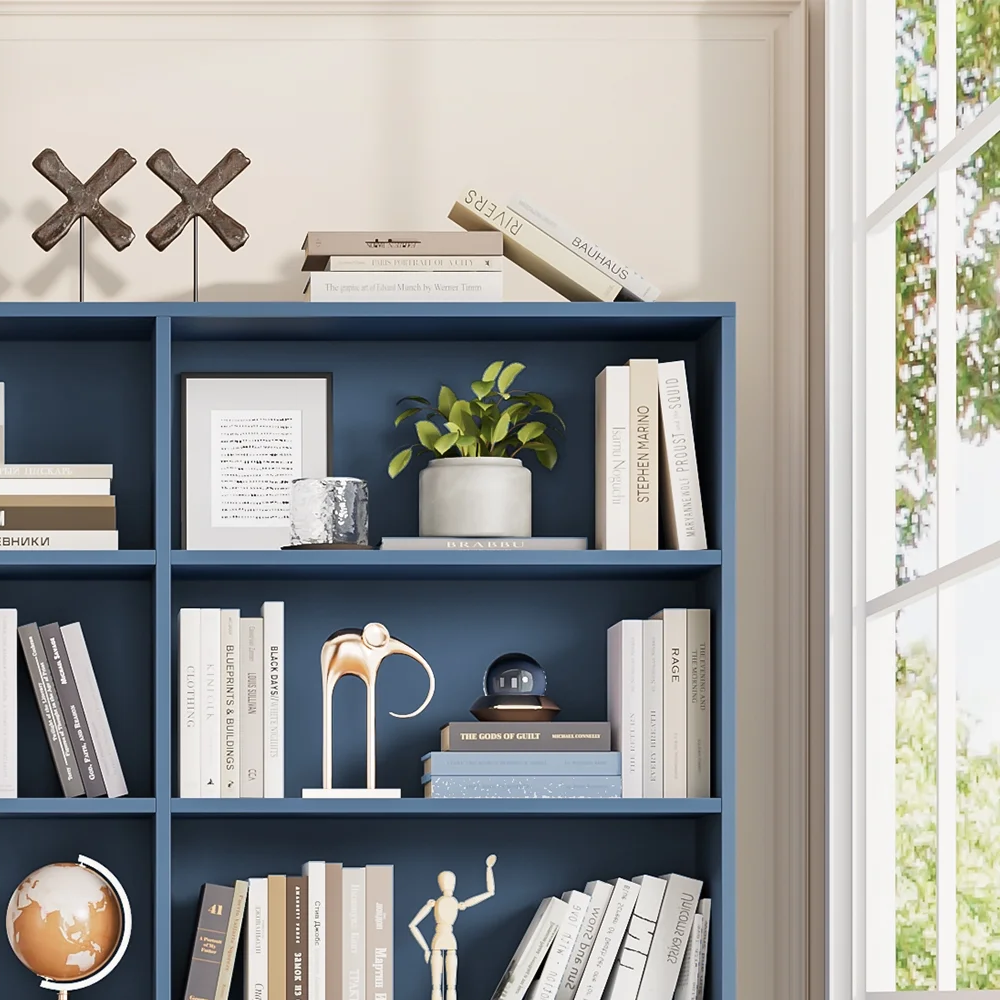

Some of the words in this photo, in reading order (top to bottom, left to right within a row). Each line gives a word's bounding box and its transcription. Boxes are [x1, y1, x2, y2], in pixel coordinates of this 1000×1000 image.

[464, 188, 523, 236] RIVERS
[571, 236, 628, 281] BAUHAUS
[612, 426, 626, 457] Isamu
[637, 405, 650, 450] MARINO
[608, 460, 626, 505] Noguchi
[637, 452, 650, 503] STEPHEN
[446, 540, 525, 548] BRABBU
[226, 644, 235, 706] BLUEPRINTS
[247, 672, 257, 688] LOUIS
[671, 647, 680, 683] RAGE
[186, 665, 196, 728] CLOTHING
[226, 708, 235, 716] &
[247, 689, 257, 715] SULLIVAN
[226, 718, 235, 771] BUILDINGS
[460, 732, 478, 740] THE
[479, 732, 502, 740] GODS
[502, 732, 515, 740] OF
[516, 732, 541, 740] GUILT
[207, 903, 223, 916] 41
[374, 947, 387, 988] Мартин
